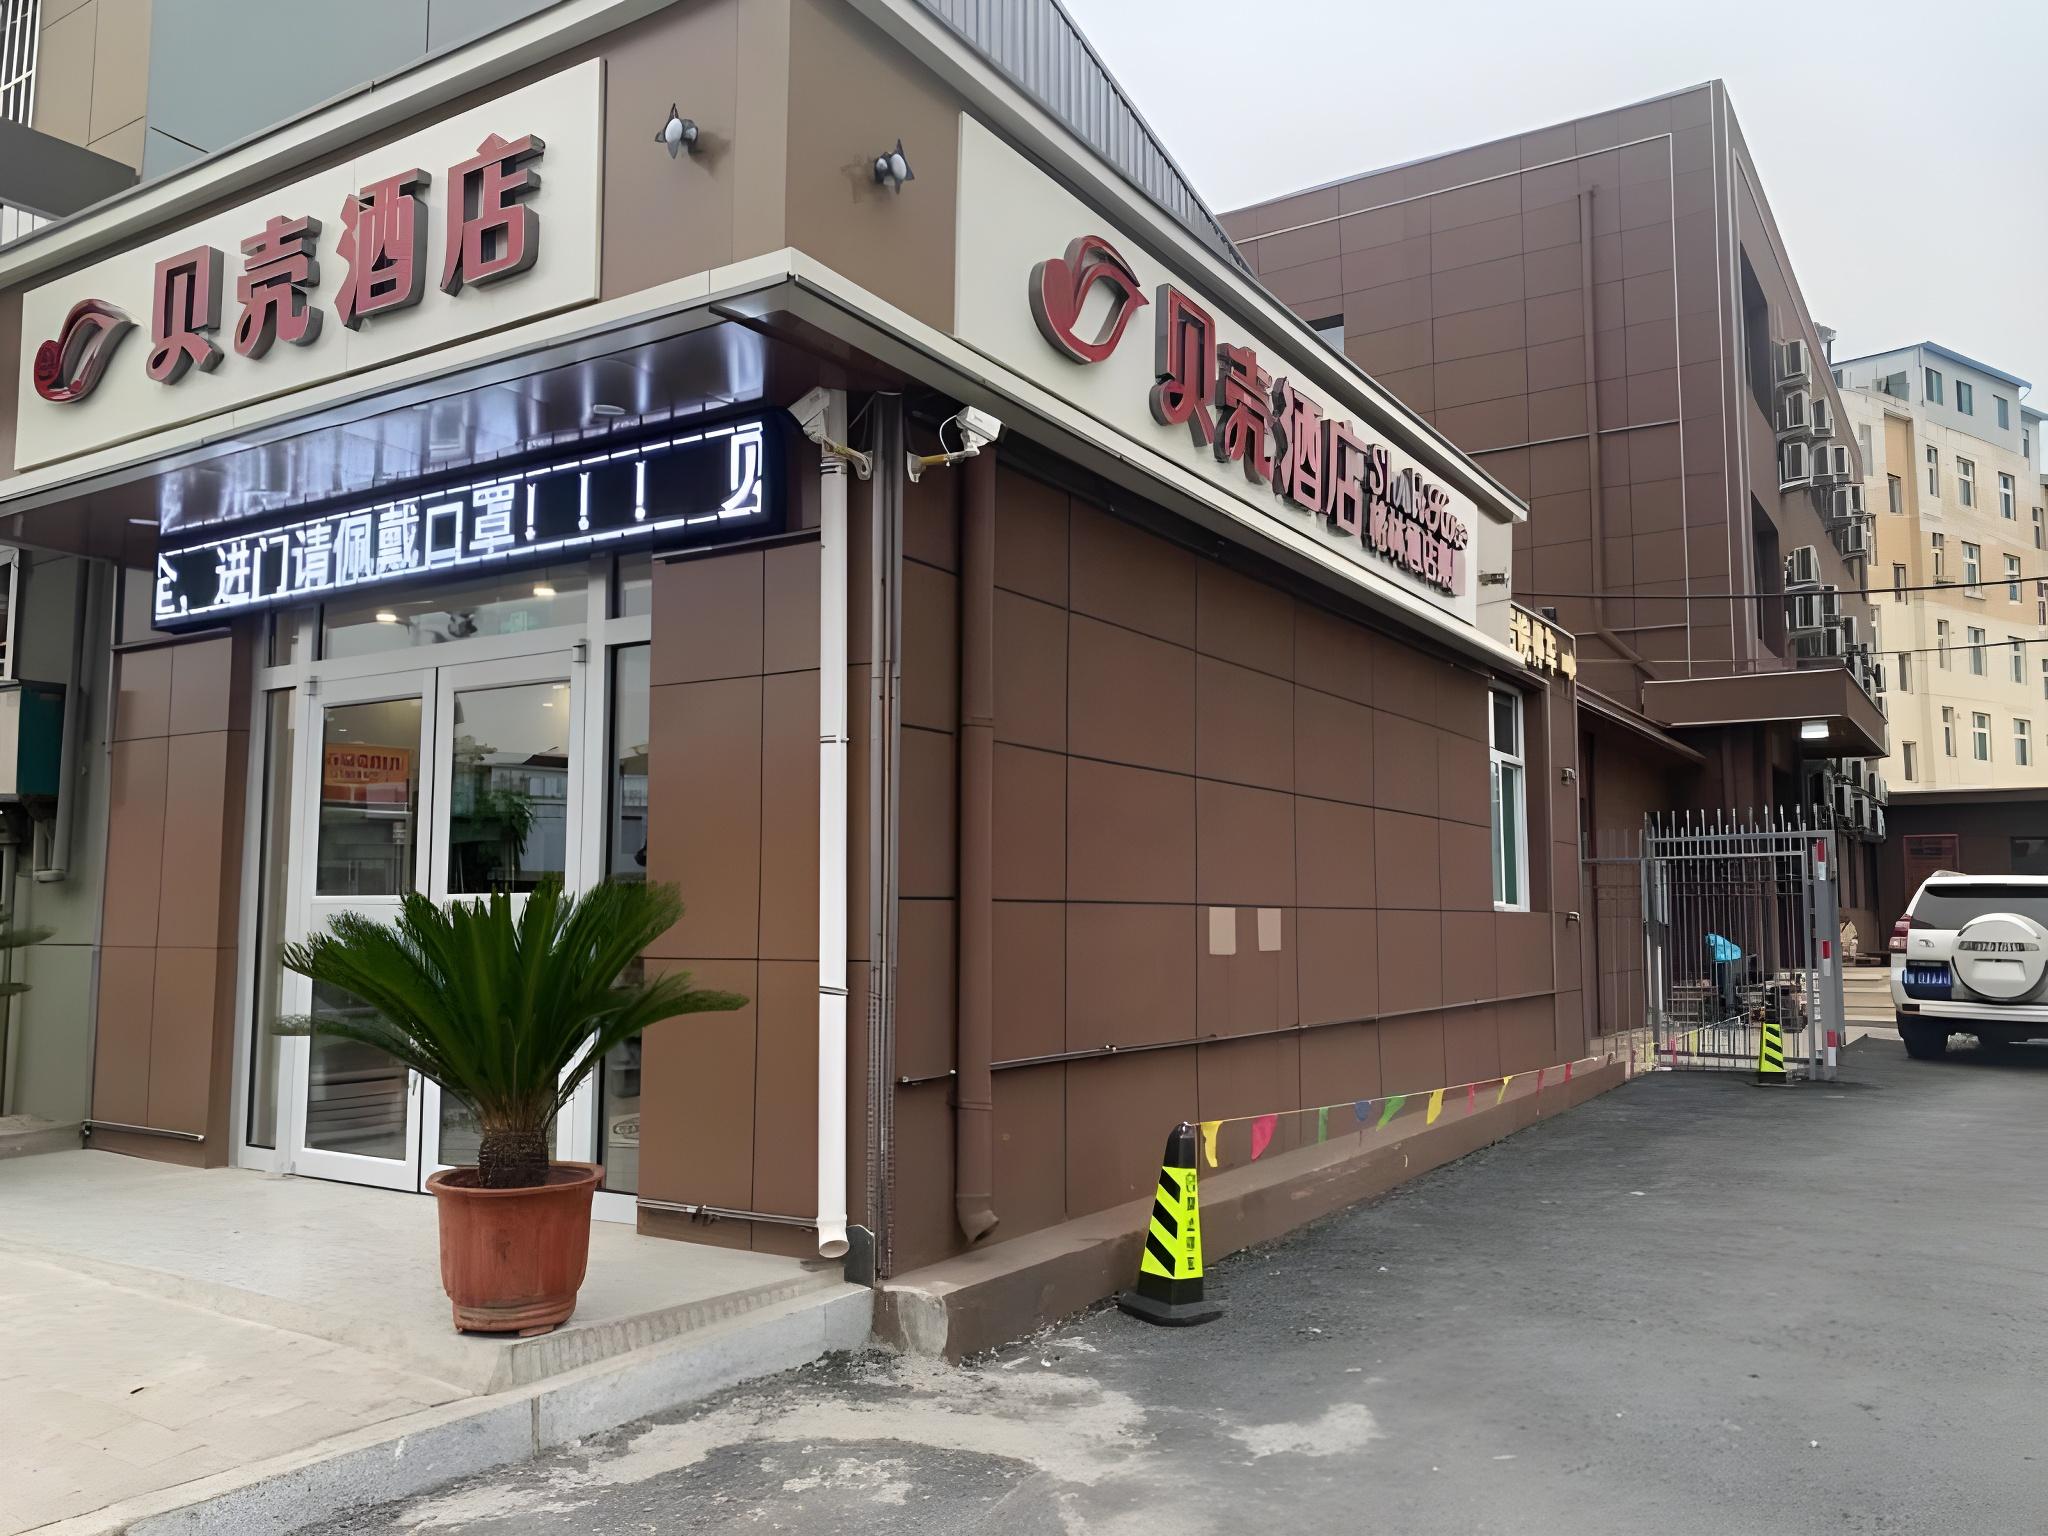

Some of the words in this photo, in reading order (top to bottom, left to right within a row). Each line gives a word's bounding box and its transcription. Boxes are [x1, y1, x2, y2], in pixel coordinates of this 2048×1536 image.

[146, 132, 545, 386] 贝壳酒店
[1149, 283, 1368, 539] 贝壳酒店
